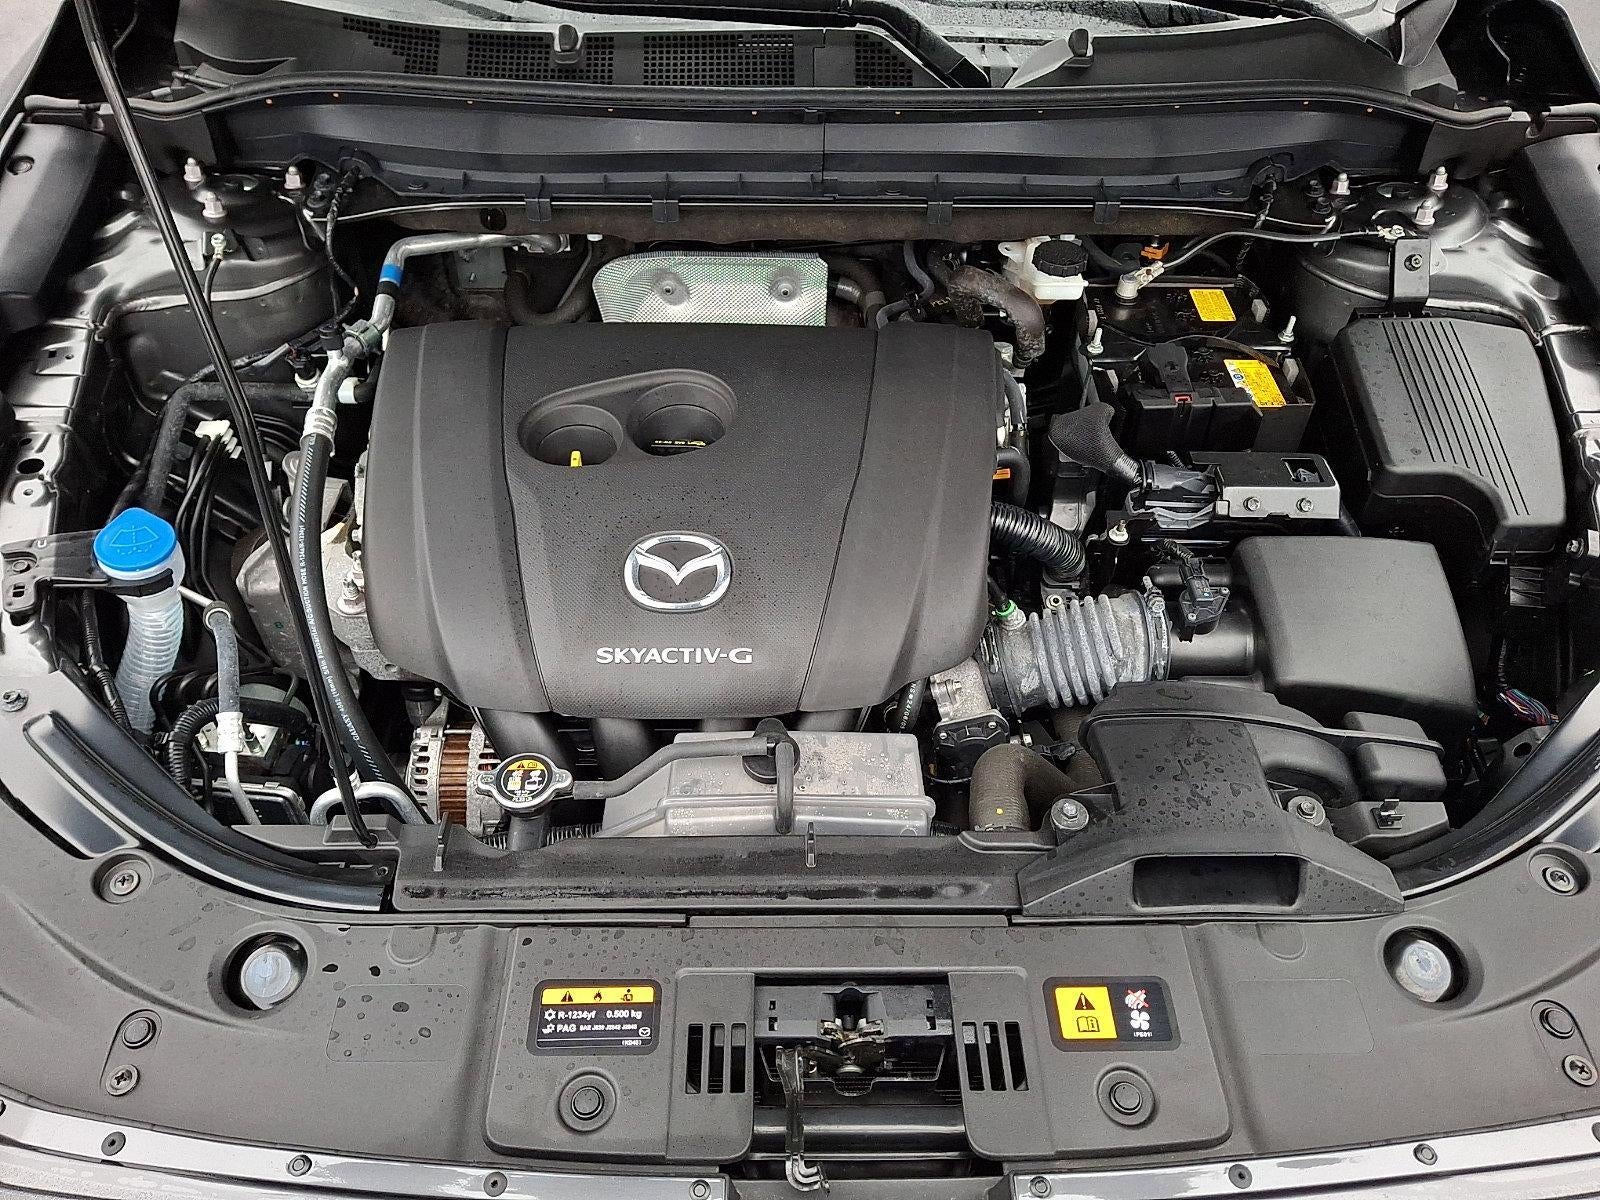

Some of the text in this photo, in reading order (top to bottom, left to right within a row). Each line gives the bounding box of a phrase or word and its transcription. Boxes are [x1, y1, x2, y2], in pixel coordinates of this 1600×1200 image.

[300, 568, 308, 584] HOSE
[303, 586, 312, 612] SUCTION
[595, 647, 754, 664] SKYACTIV-G
[341, 713, 360, 741] GALAXY
[557, 1009, 643, 1020] R-1234yf 0.500 kg
[556, 1024, 577, 1033] PAG
